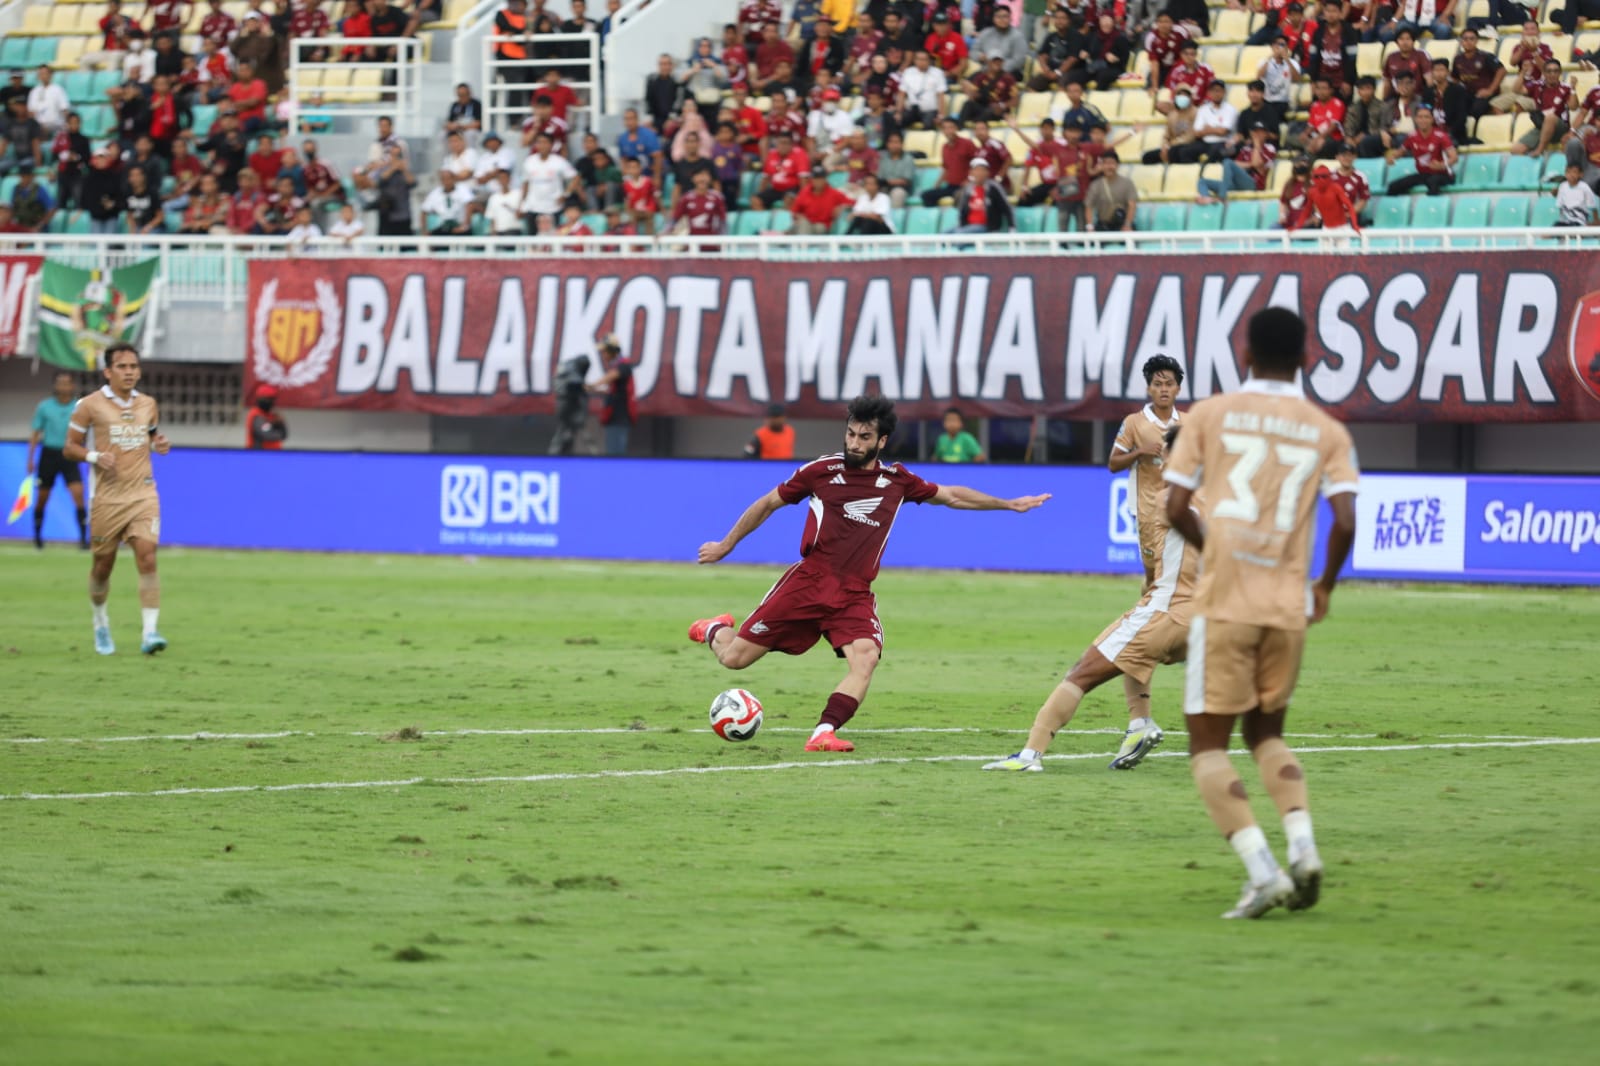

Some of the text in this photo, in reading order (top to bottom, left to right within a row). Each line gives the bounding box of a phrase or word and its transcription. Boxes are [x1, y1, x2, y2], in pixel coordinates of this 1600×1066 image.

[336, 274, 770, 402] BALAIKOTA
[784, 277, 1044, 401] MANIA
[491, 470, 561, 525] BRI
[1213, 433, 1320, 532] 37
[1373, 518, 1446, 551] MOVE
[1375, 496, 1441, 525] LET'S
